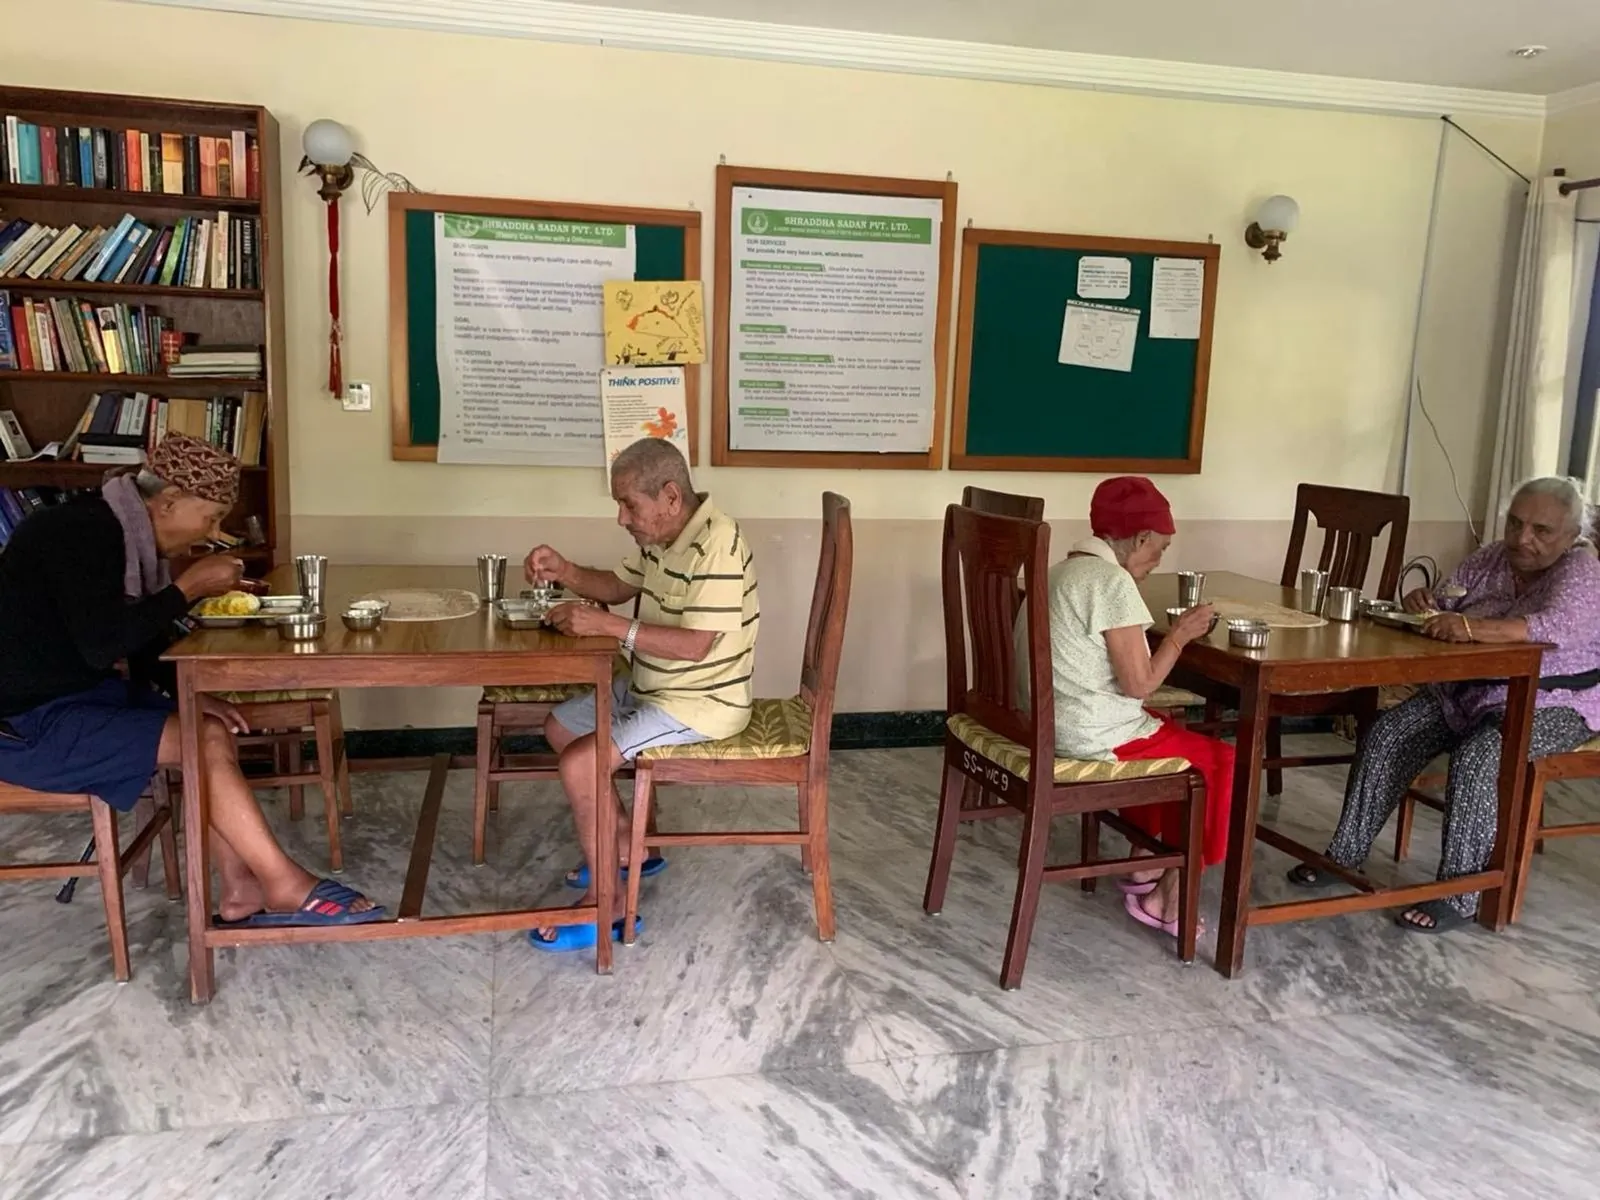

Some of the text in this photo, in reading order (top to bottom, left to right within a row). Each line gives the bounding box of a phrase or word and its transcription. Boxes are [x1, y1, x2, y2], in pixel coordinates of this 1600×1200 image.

[537, 222, 569, 233] SADAN
[571, 225, 593, 235] PVT.
[594, 226, 617, 237] LTD.
[784, 215, 912, 232] SHRADDHA SADAN PVT. LTD.
